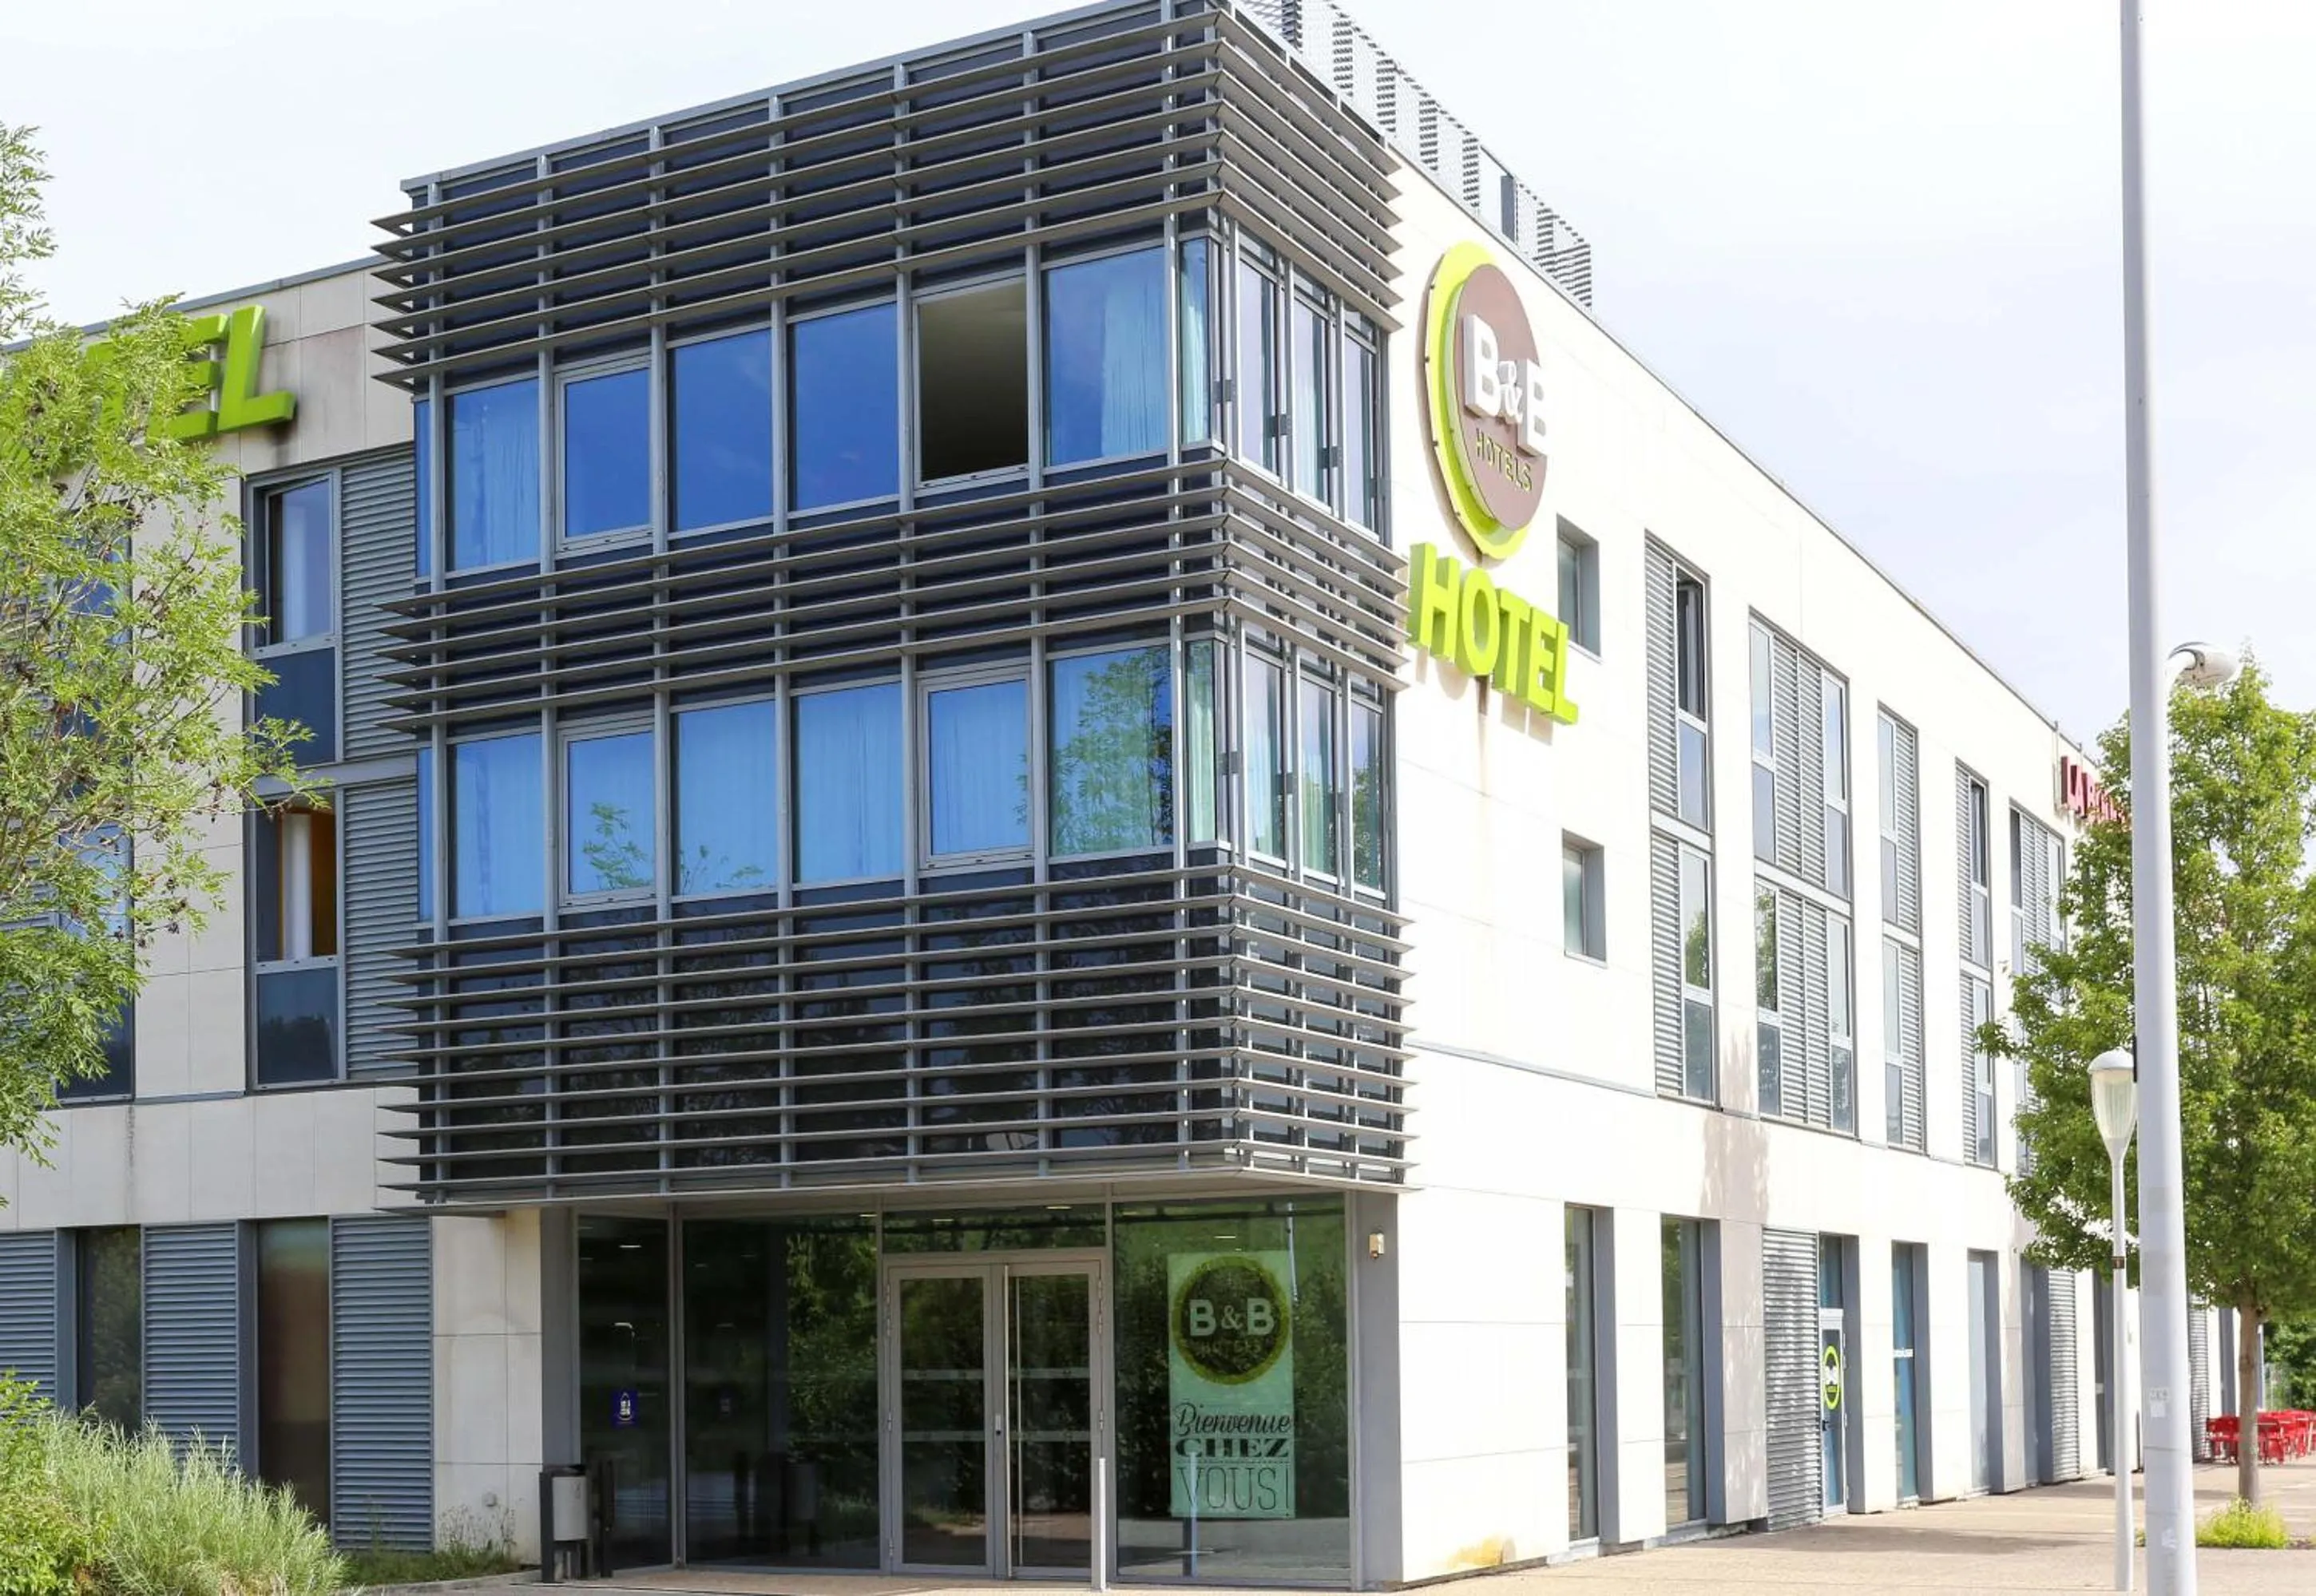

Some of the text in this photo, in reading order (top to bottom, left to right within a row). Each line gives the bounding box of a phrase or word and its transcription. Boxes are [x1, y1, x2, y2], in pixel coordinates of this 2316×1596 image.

[1463, 314, 1549, 456] B&B
[1475, 426, 1533, 493] HOTELS
[1406, 543, 1578, 725] HOTEL
[1189, 1297, 1275, 1337] B&B
[1174, 1401, 1291, 1436] Bienvenue
[1176, 1438, 1290, 1459] CHEZ
